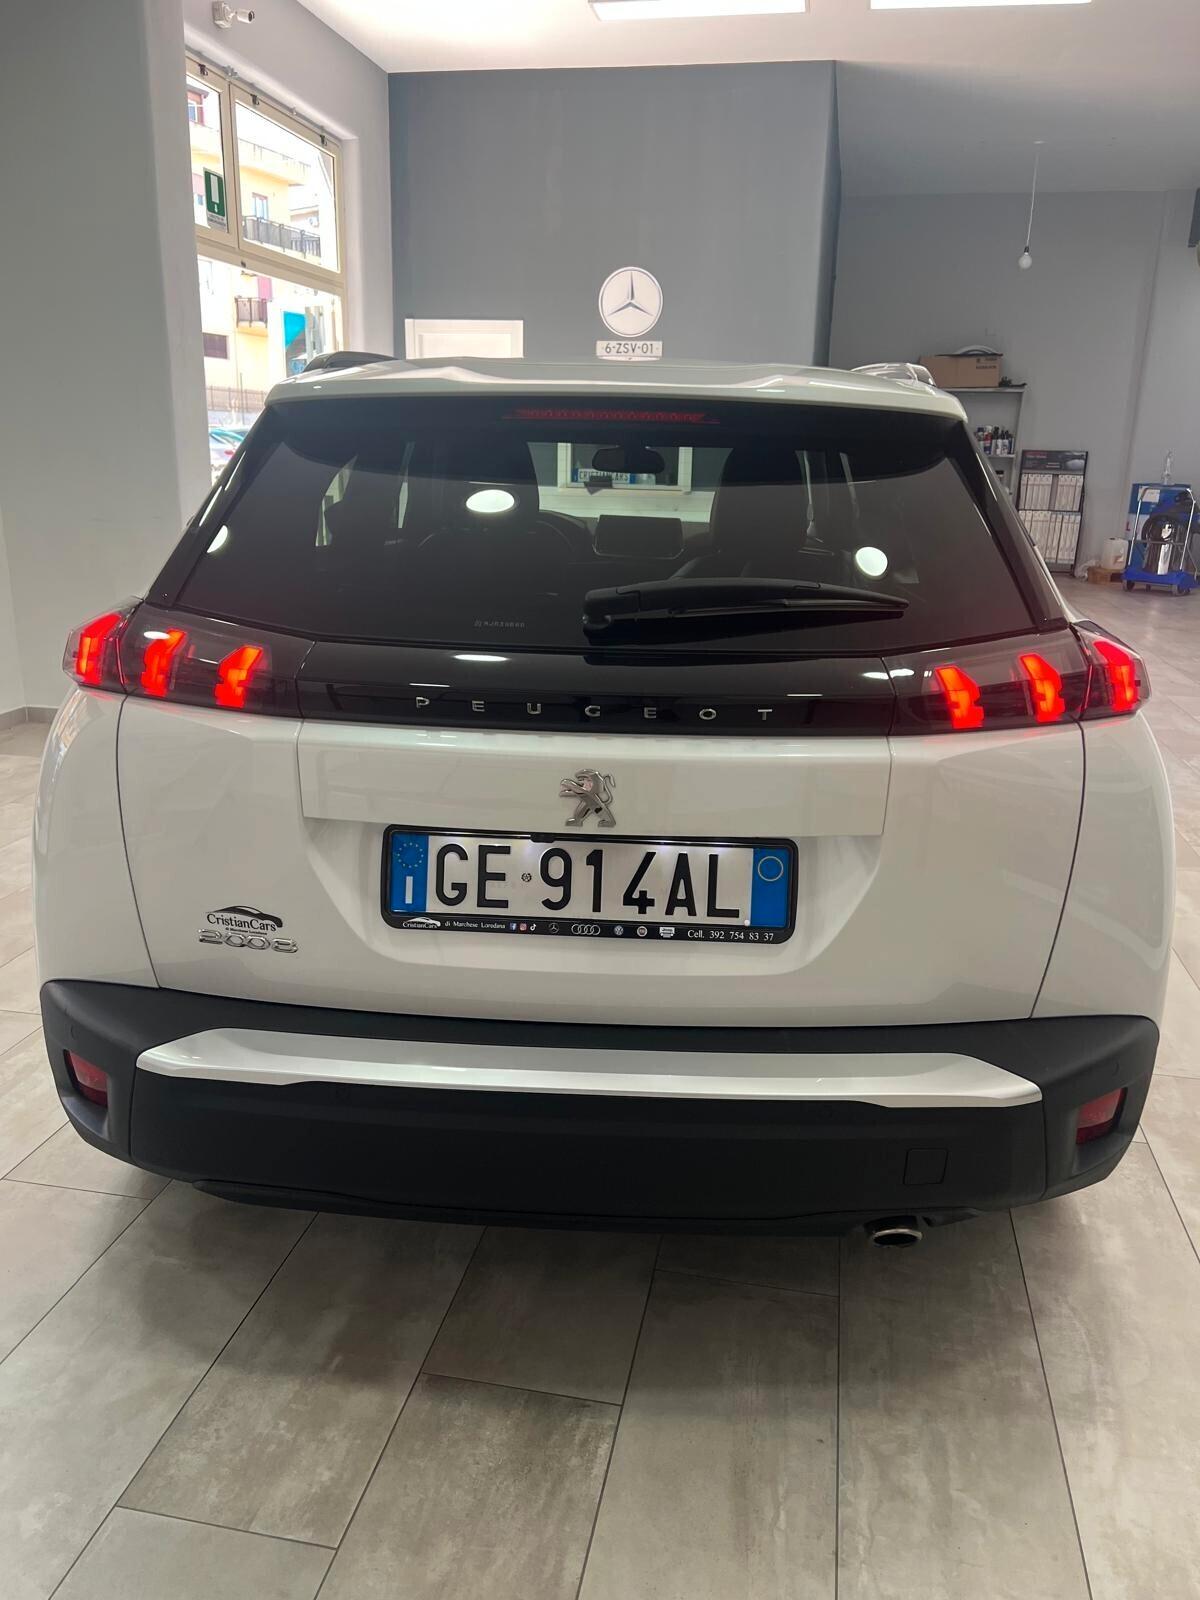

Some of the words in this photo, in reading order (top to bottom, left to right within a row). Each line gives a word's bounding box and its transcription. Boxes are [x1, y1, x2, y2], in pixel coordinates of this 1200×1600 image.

[415, 696, 773, 722] PEUGEOT
[435, 843, 511, 909] GE
[206, 913, 277, 932] CristianCars
[402, 921, 438, 929] CristianCars
[198, 929, 299, 954] 2008
[687, 929, 705, 939] Cell.
[709, 930, 725, 939] 392
[729, 931, 745, 940] 754
[748, 932, 760, 940] 83
[763, 932, 774, 941] 37
